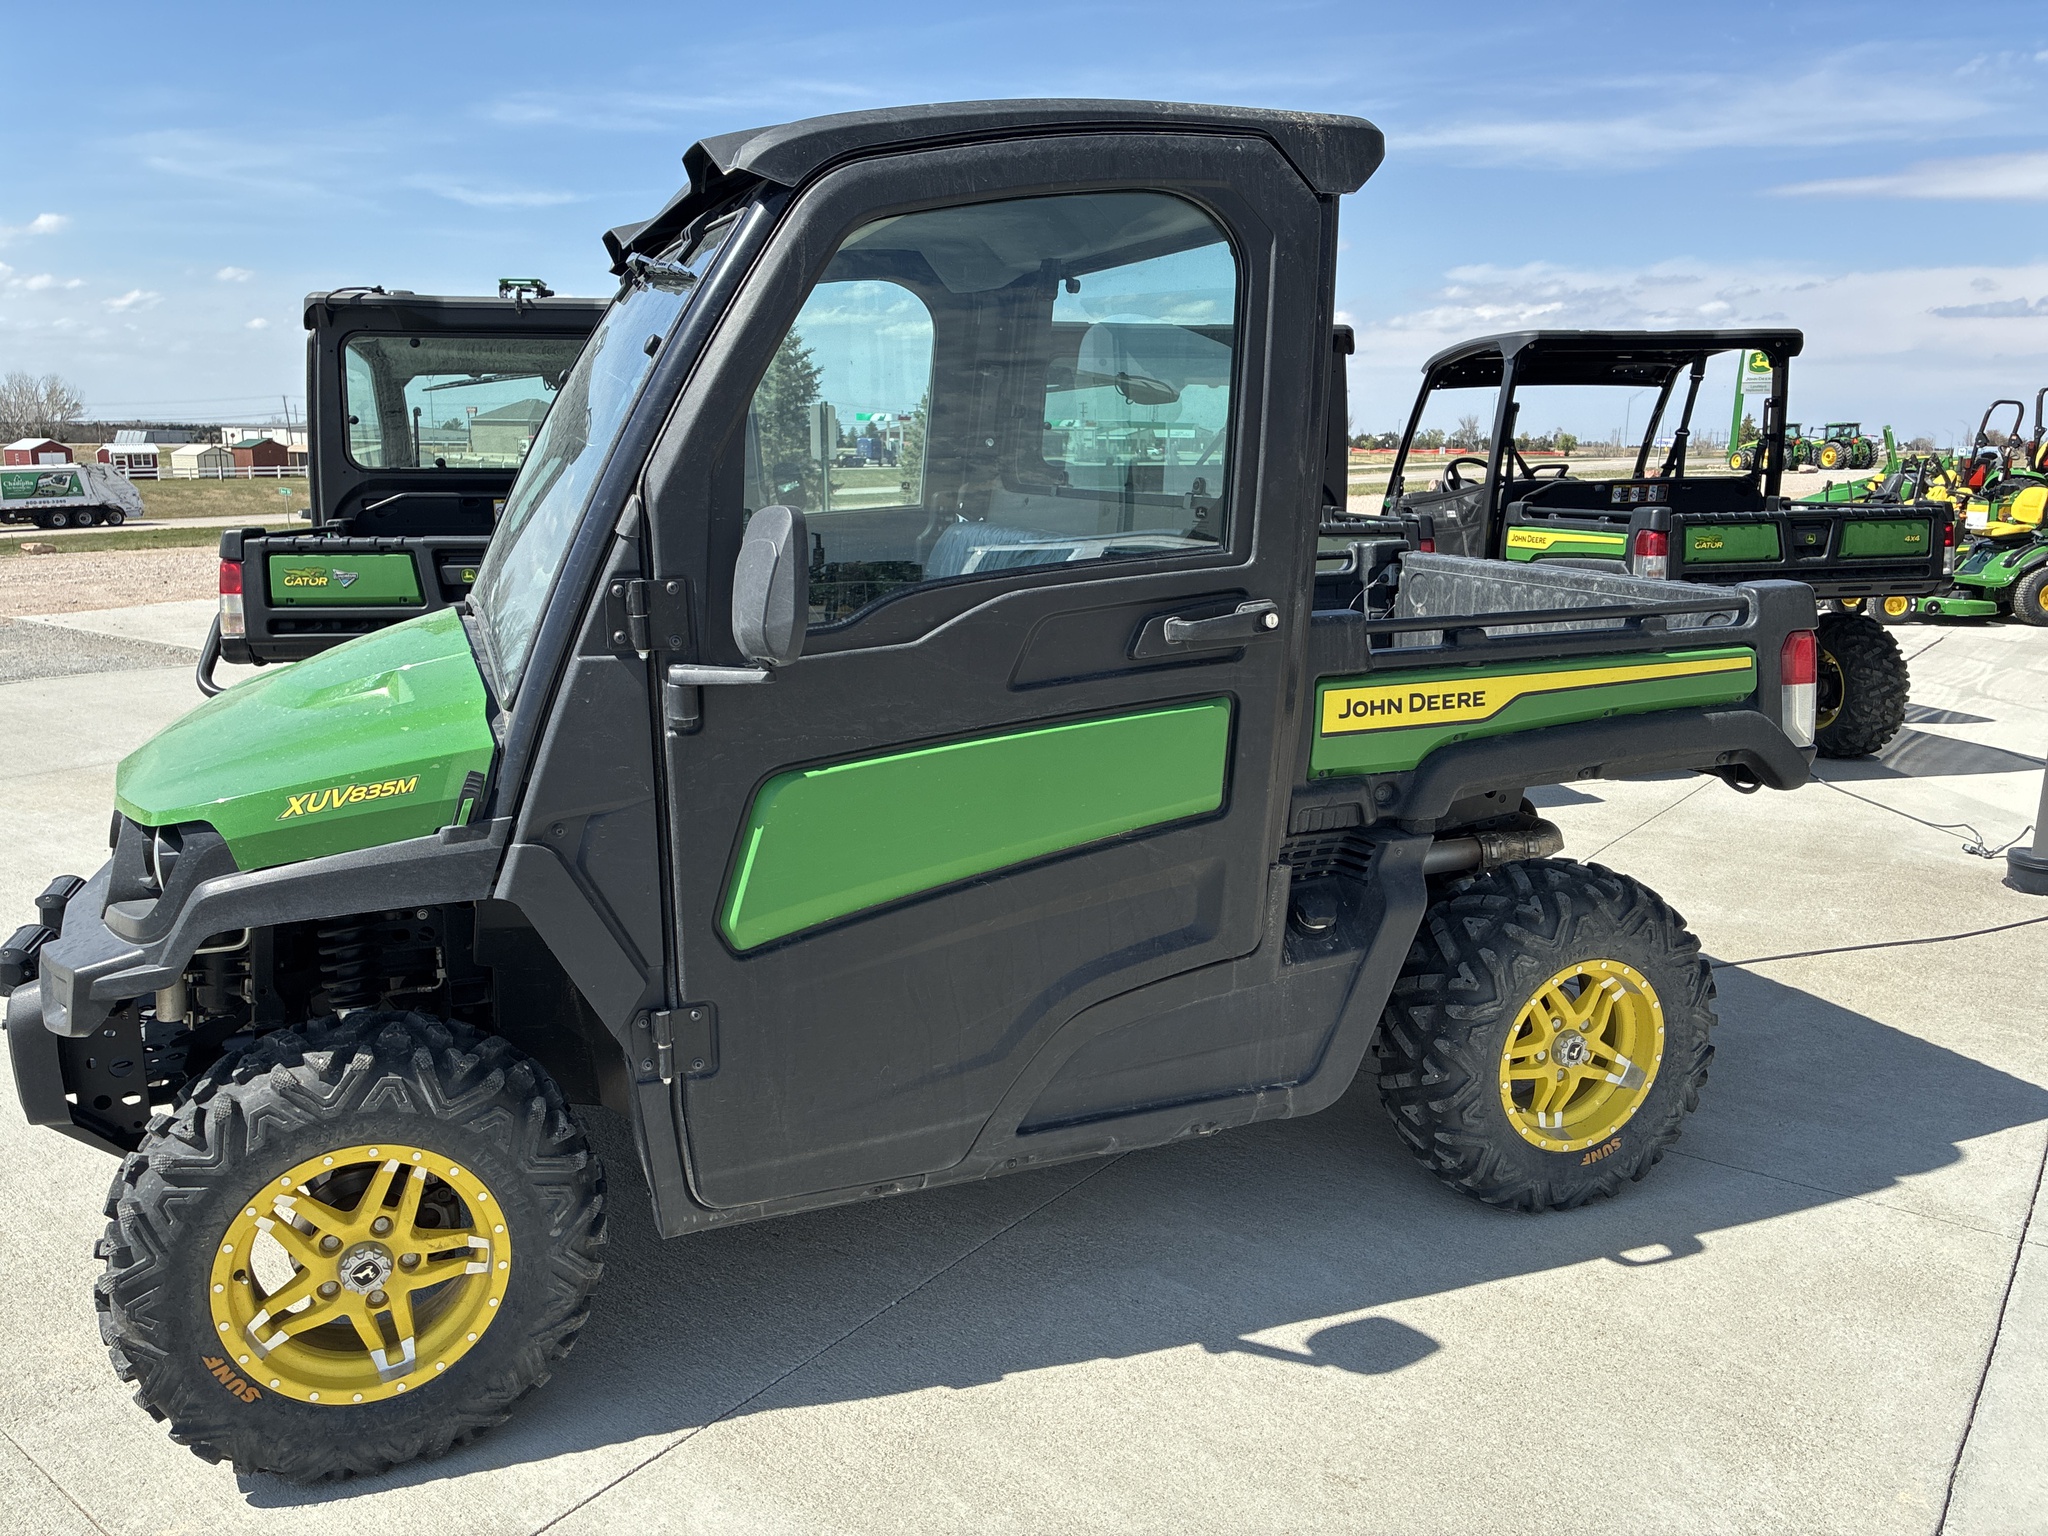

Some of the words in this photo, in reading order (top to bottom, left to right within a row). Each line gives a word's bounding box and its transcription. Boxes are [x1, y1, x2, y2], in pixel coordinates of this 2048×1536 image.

[1512, 534, 1527, 543] JOHN
[1527, 535, 1547, 545] DEERE
[1694, 541, 1723, 549] GATOR
[284, 576, 328, 586] GATOR
[1338, 697, 1402, 719] JOHN
[1409, 691, 1485, 713] DEERE
[279, 776, 419, 819] XUV835M
[1580, 1137, 1622, 1166] SUNF
[201, 1356, 263, 1403] SUNF
